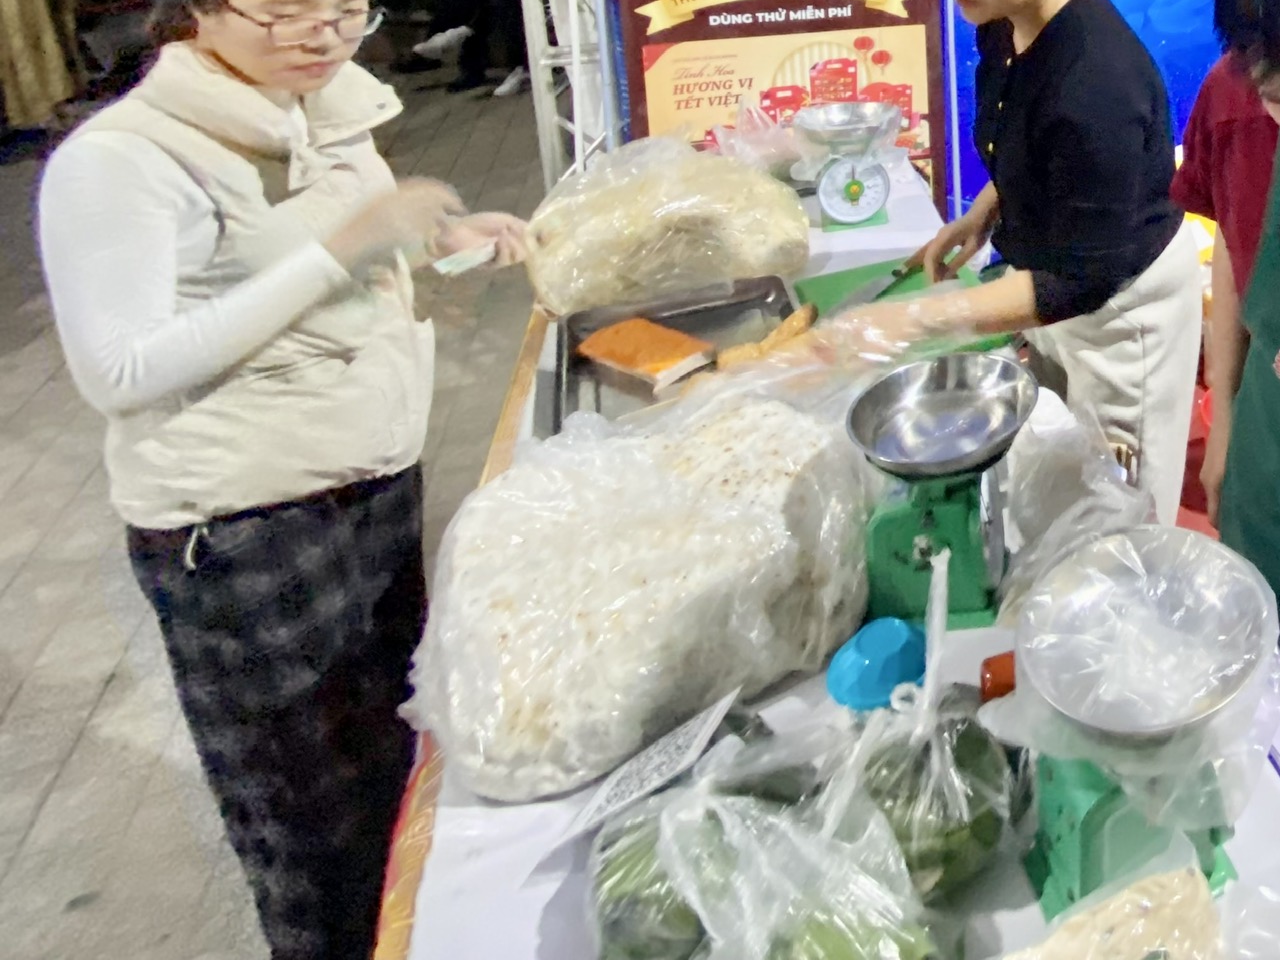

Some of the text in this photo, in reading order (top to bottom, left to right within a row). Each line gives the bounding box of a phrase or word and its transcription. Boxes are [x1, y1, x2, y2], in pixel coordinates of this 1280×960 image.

[708, 4, 852, 26] DÙNG THỬ MIỄN PHÍ
[673, 77, 754, 96] HƯƠNG VỊ
[675, 92, 742, 110] TẾT VIỆT
